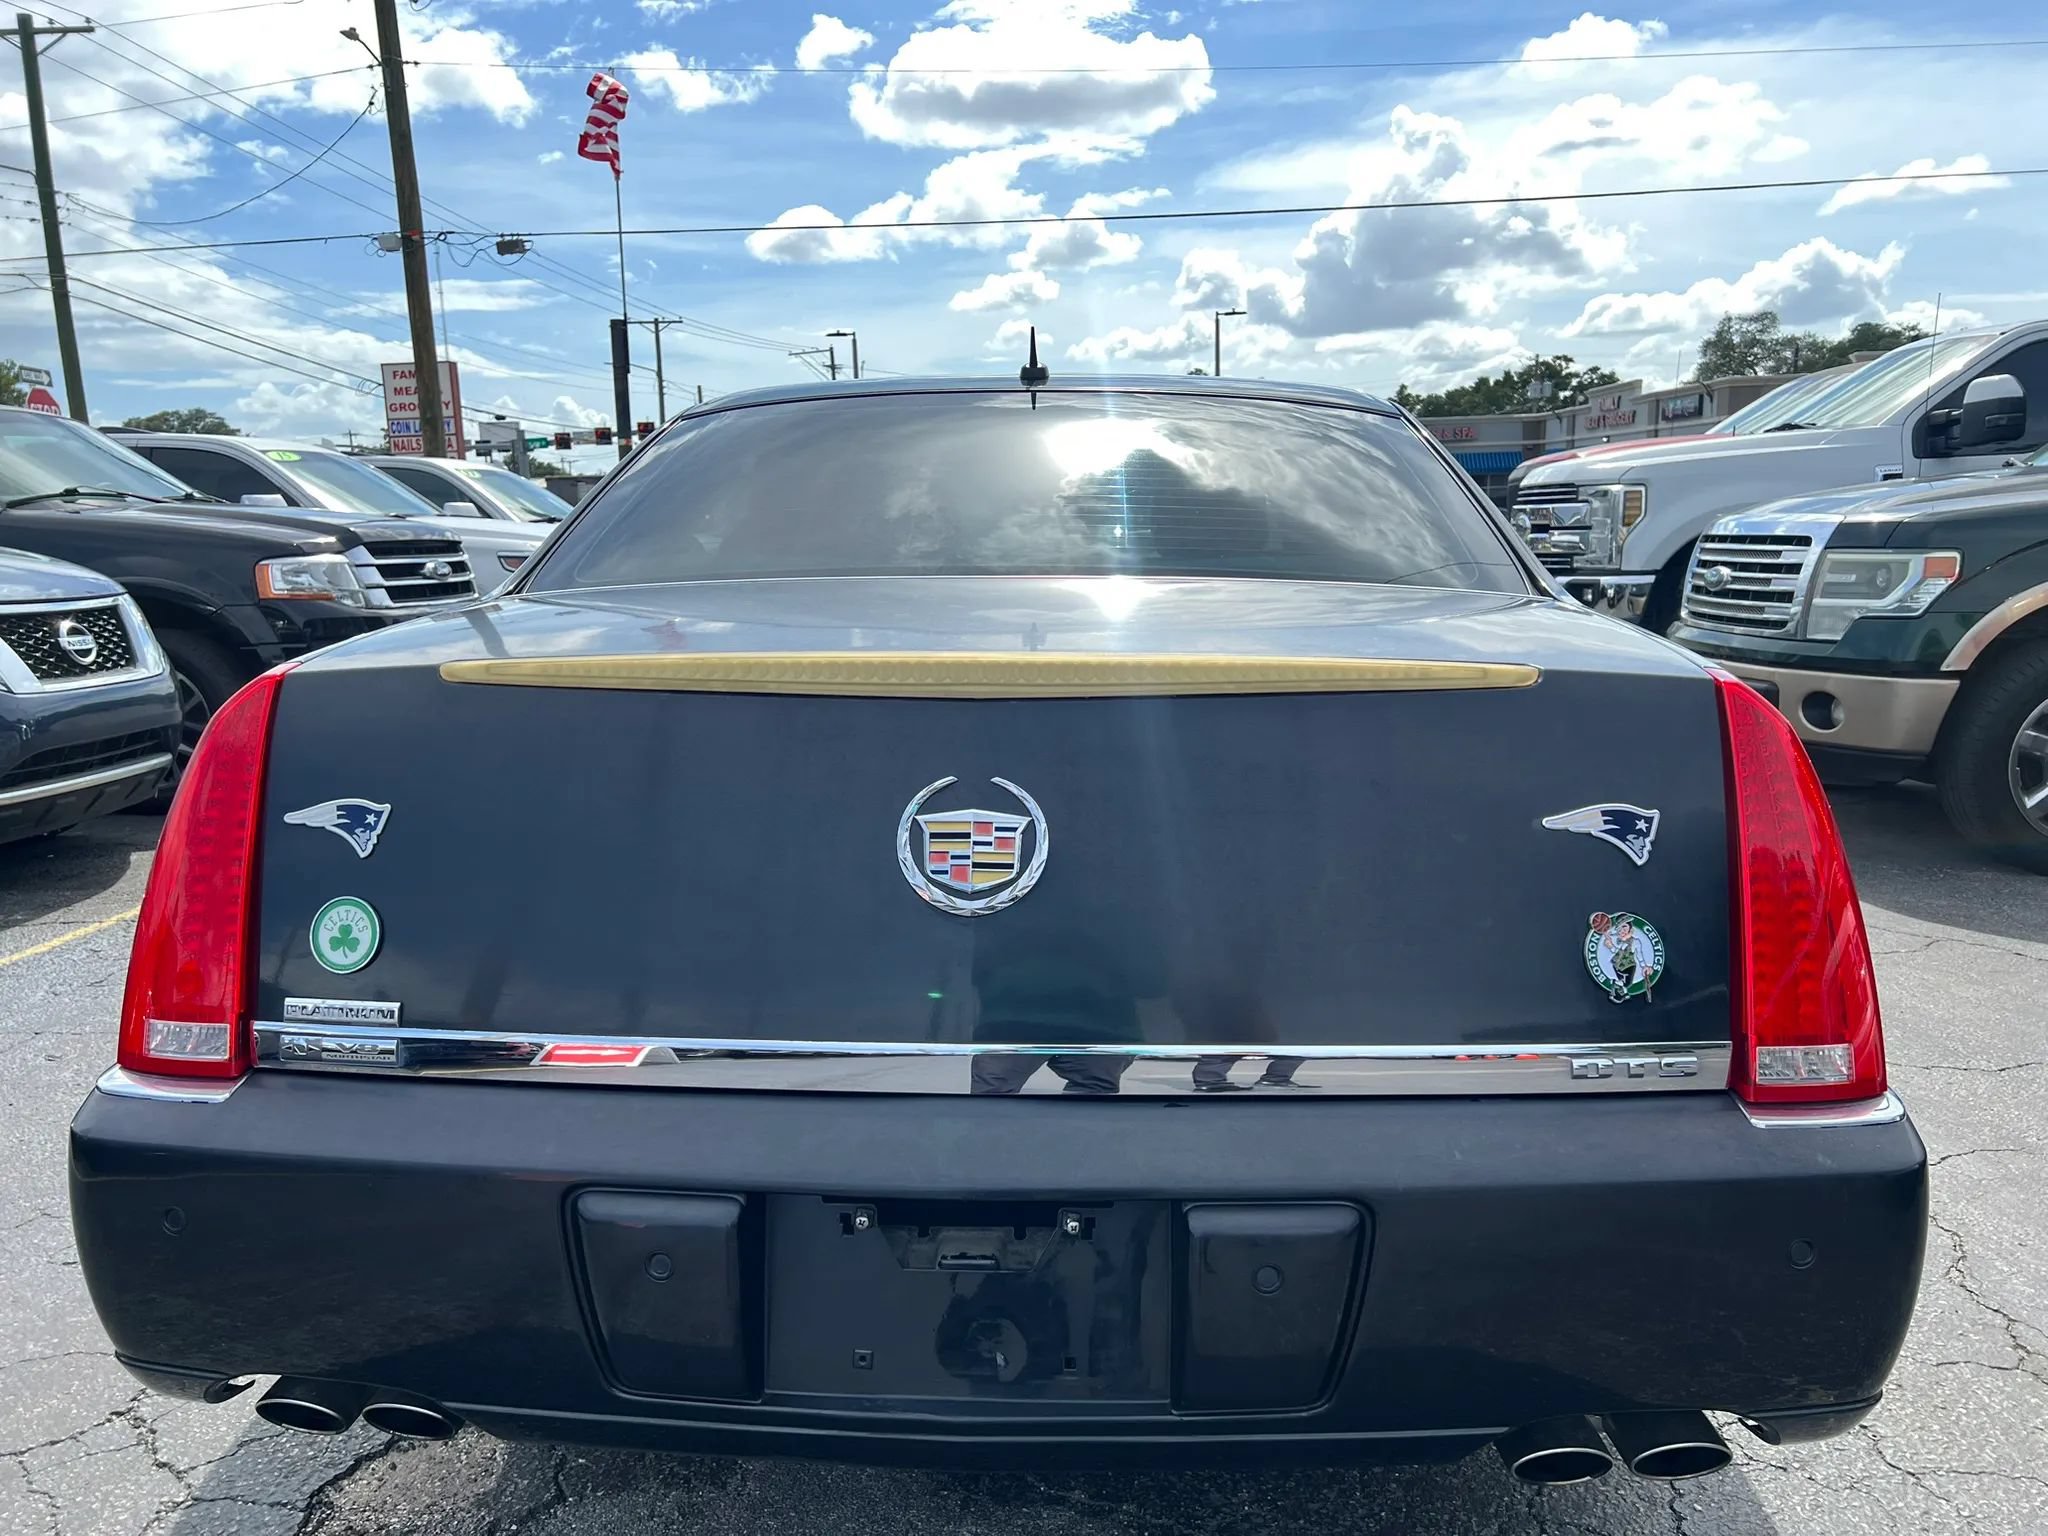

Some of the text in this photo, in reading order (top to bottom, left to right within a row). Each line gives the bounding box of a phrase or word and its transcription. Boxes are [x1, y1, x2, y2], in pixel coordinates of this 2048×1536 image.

[393, 370, 417, 380] FAM
[391, 421, 411, 434] COIN
[1454, 427, 1478, 440] SPA
[393, 438, 422, 452] NAILS
[323, 909, 369, 933] CELTICS
[1588, 925, 1663, 983] BOSTON CELTICS
[286, 1004, 396, 1019] PLATINUM
[335, 1041, 380, 1055] V8
[1571, 1056, 1698, 1080] DTS
